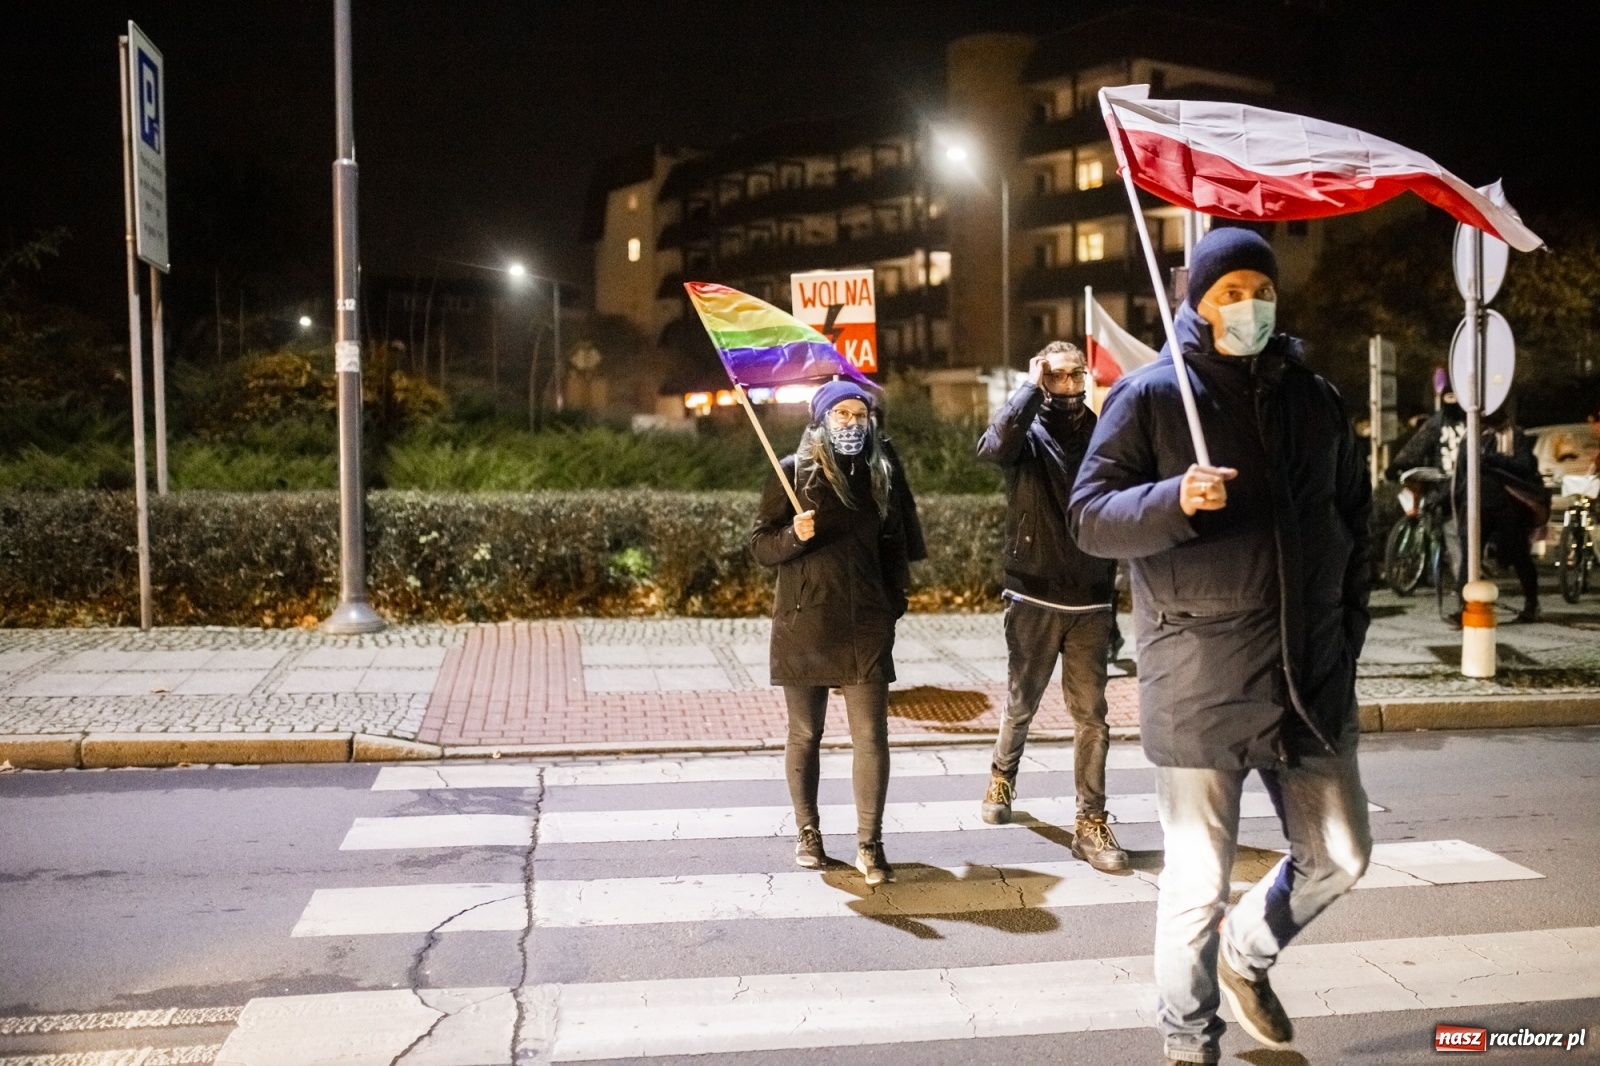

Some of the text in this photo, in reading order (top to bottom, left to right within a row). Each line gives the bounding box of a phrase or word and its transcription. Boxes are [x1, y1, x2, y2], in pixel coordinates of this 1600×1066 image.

[142, 62, 156, 134] P
[798, 278, 873, 308] WOLNA
[833, 338, 876, 367] KA
